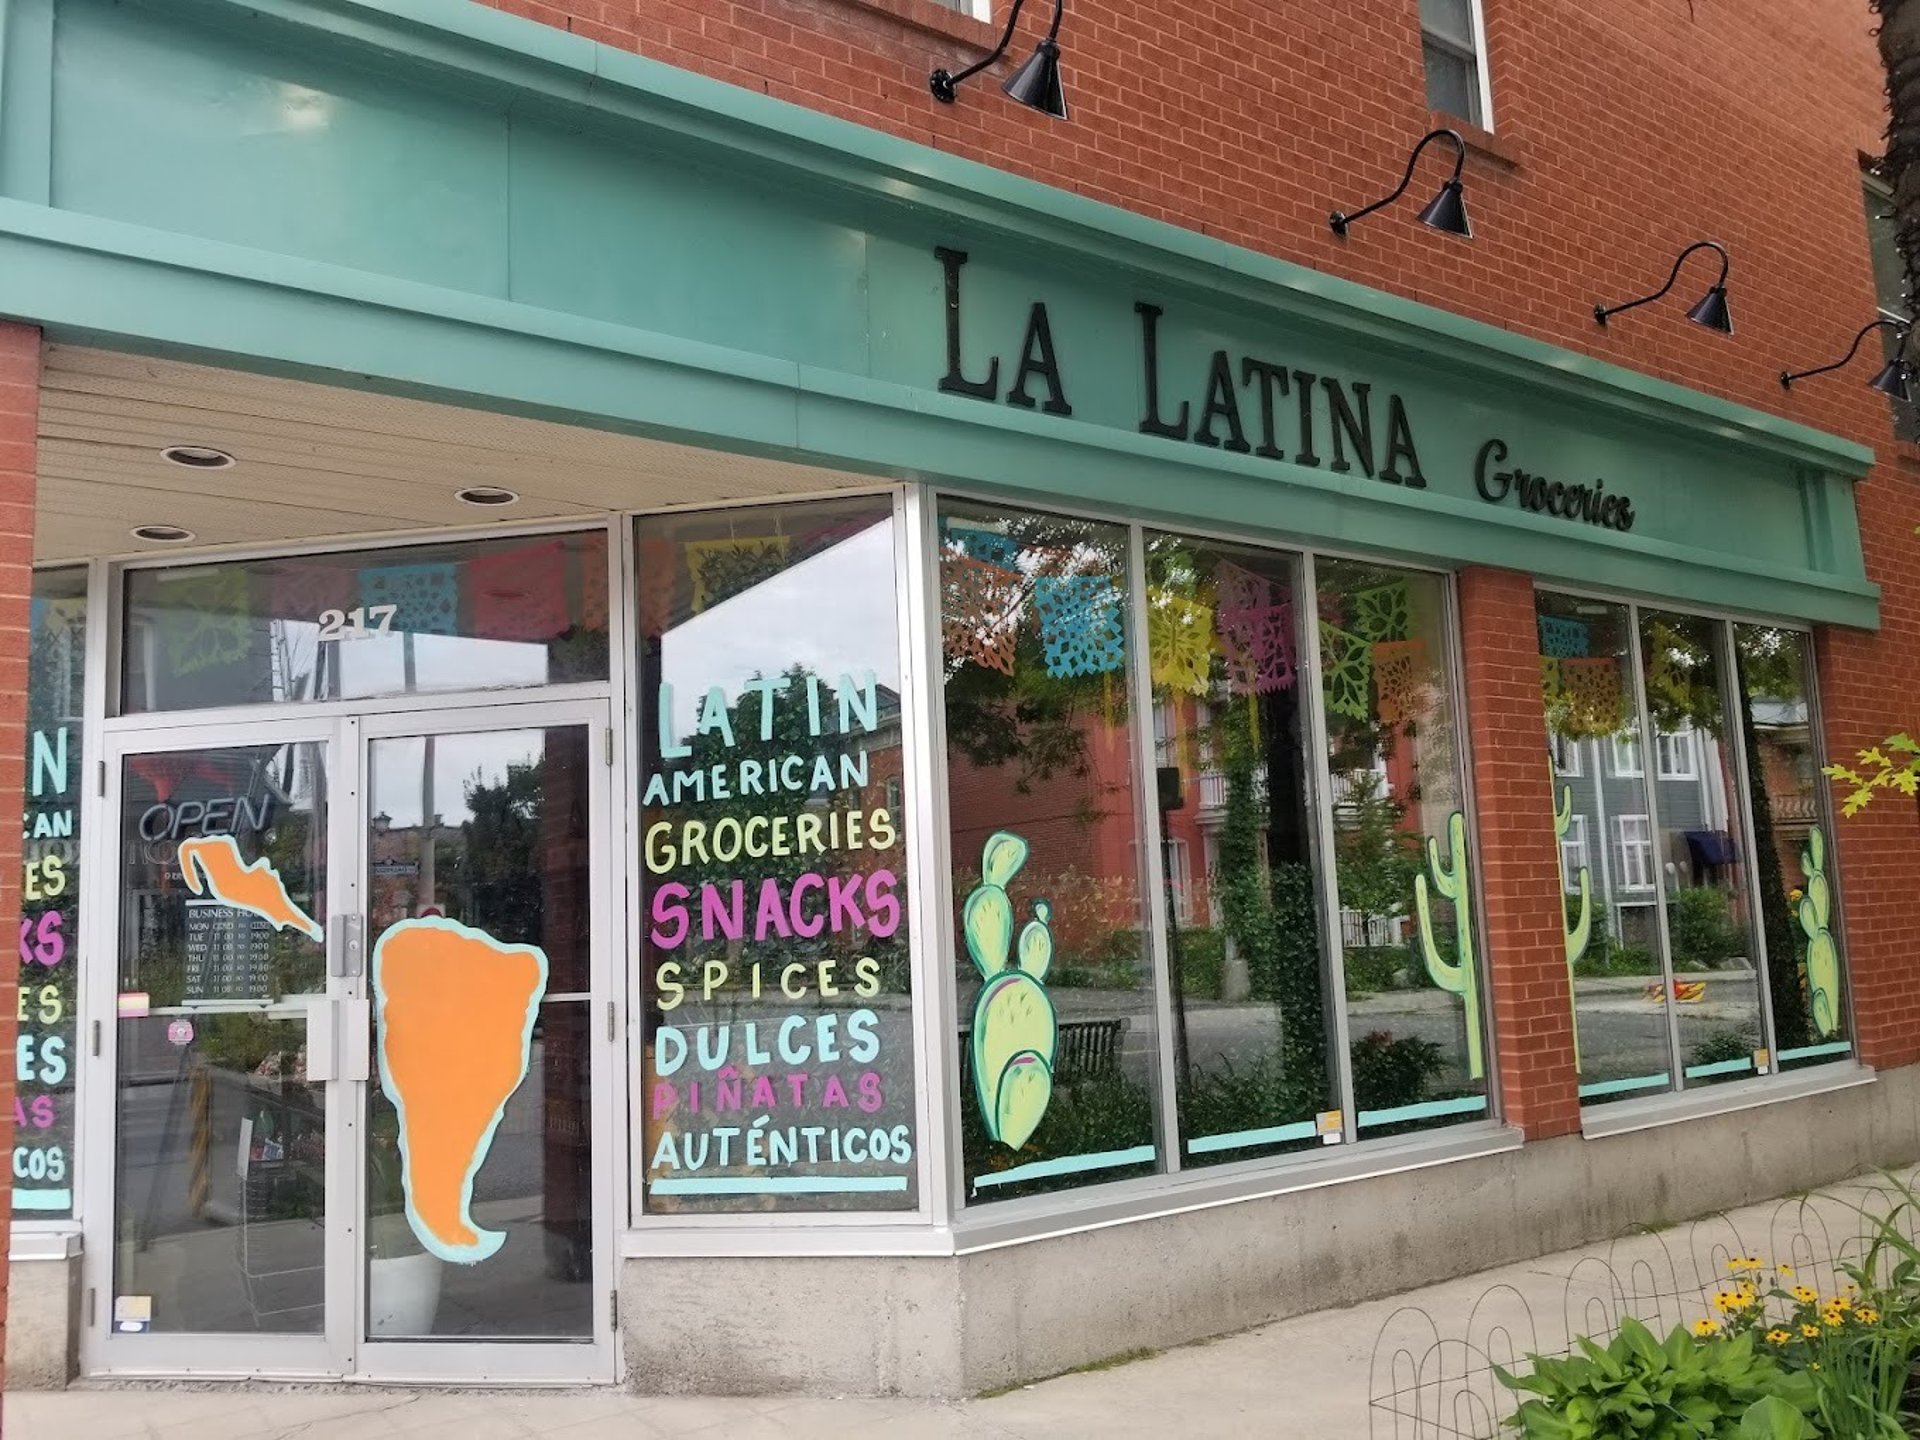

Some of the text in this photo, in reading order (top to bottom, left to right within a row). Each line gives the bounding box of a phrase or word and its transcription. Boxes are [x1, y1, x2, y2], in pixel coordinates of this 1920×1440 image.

[935, 245, 1426, 488] LA LATINA
[1474, 438, 1635, 532] Groceries
[319, 604, 397, 641] 217
[658, 670, 877, 758] LATIN
[642, 751, 868, 806] AMERICAN
[139, 794, 270, 841] OPEN
[645, 808, 896, 874] GROCERIES
[189, 908, 233, 919] BUSINESS
[651, 869, 900, 949] SNACKS
[188, 944, 207, 952] WED
[189, 933, 204, 941] TUE
[186, 975, 201, 983] SAT
[187, 965, 200, 973] FRI
[656, 957, 880, 1011] SPICES
[655, 1009, 880, 1076] DULCES
[653, 1065, 883, 1120] PIÑATAS
[651, 1115, 912, 1170] AUTÉNTICOS
